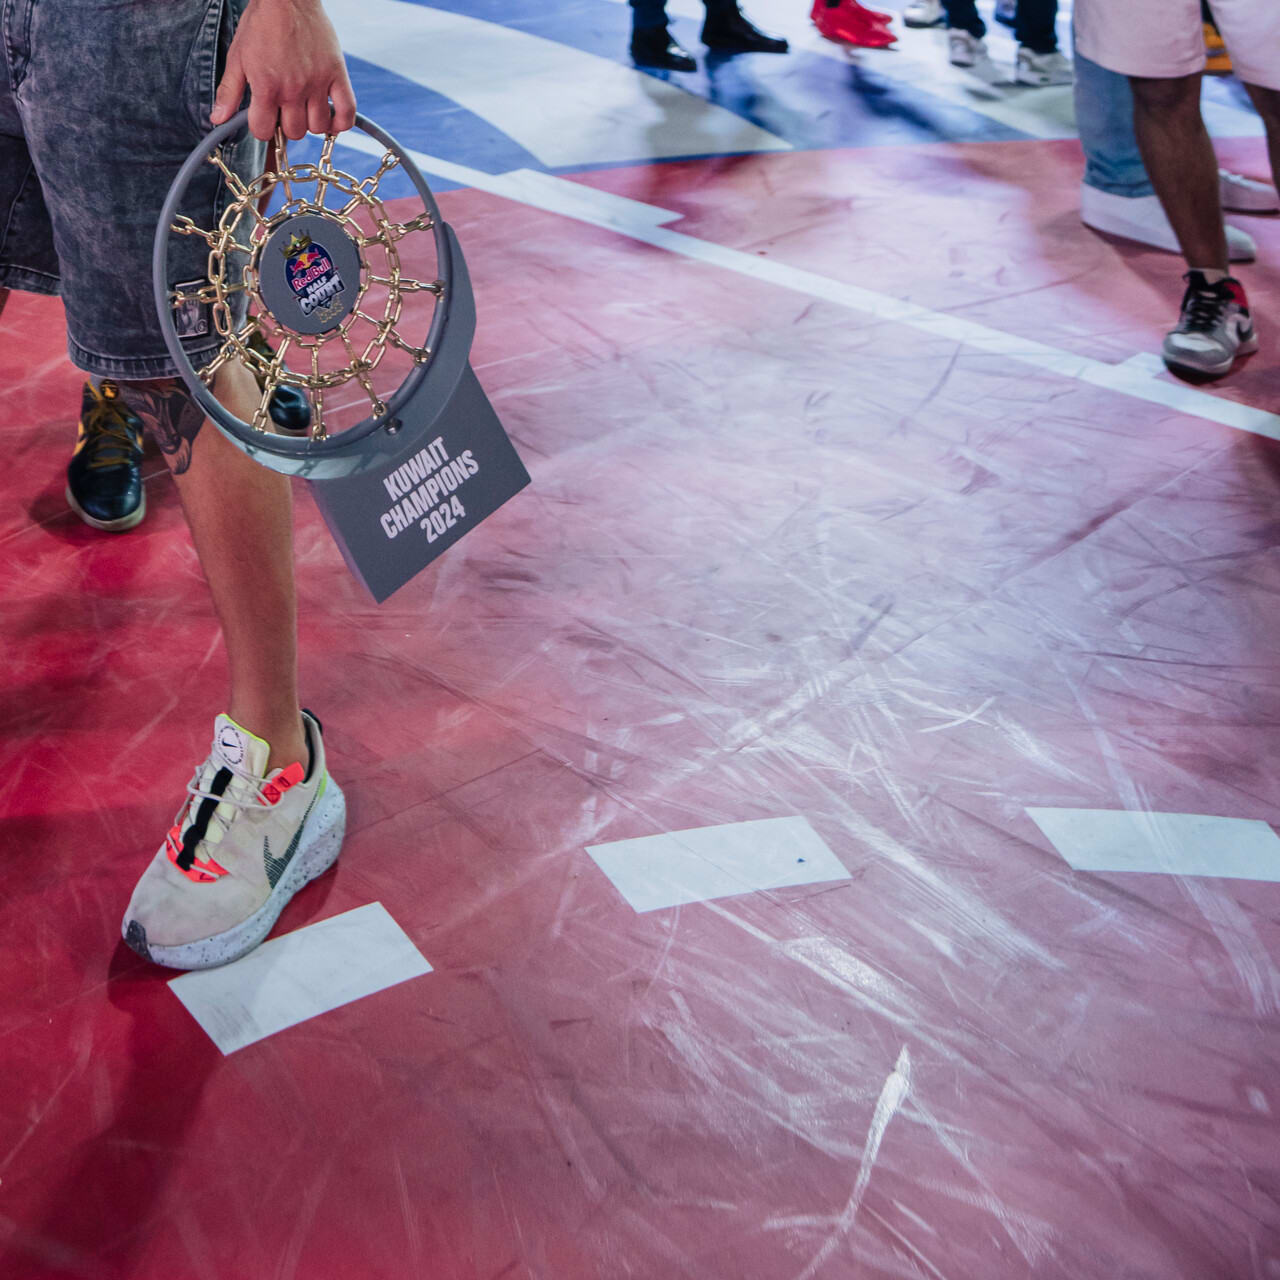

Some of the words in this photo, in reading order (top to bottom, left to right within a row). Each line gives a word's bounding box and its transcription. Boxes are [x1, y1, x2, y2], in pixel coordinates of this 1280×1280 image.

[291, 269, 314, 291] Red
[310, 257, 331, 277] Bull
[300, 274, 342, 313] COURT
[306, 276, 328, 295] HALF
[383, 436, 450, 502] KUWAIT
[380, 449, 480, 539] CHAMPIONS
[420, 495, 467, 544] 2024
